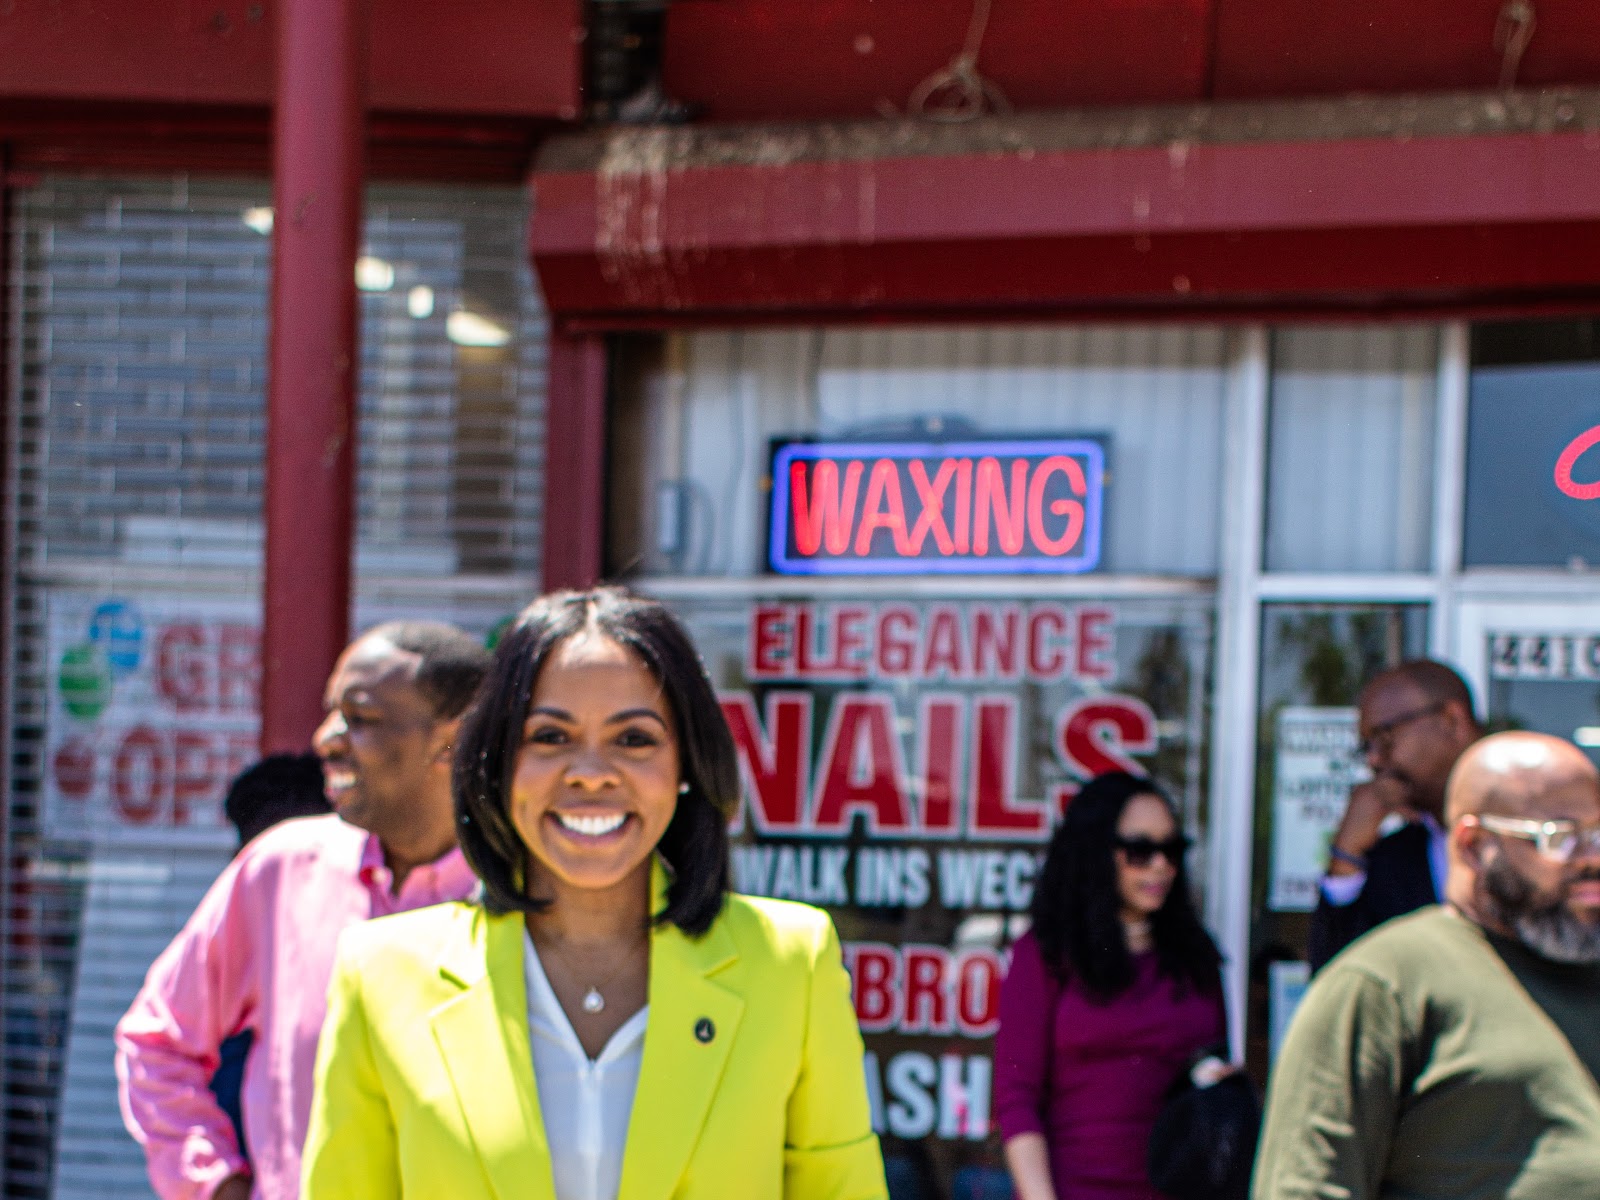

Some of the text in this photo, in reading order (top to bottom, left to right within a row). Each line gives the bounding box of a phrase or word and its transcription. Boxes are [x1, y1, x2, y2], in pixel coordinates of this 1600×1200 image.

[790, 455, 1088, 557] WAXING
[752, 606, 1116, 682] ELEGANCE
[716, 688, 1158, 839] NAILS
[732, 846, 1046, 909] WALK INS WEC
[843, 943, 1013, 1038] BRO
